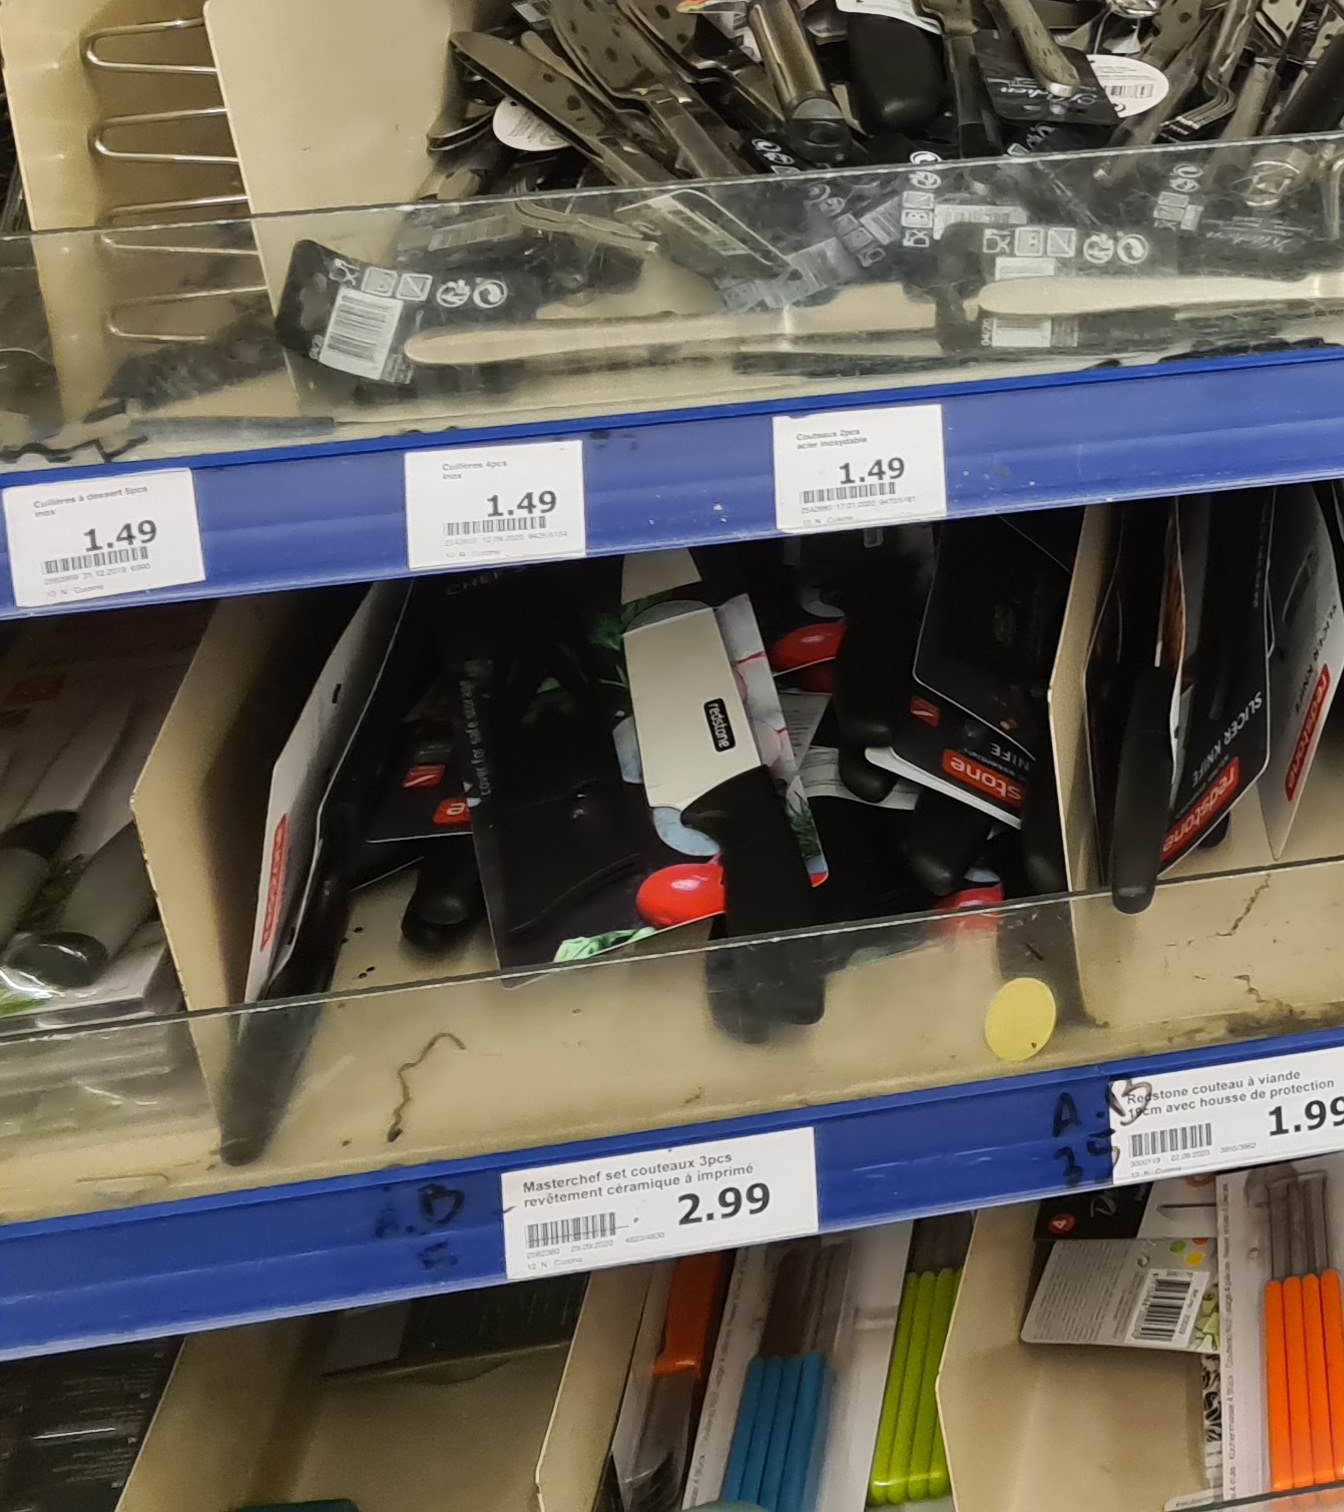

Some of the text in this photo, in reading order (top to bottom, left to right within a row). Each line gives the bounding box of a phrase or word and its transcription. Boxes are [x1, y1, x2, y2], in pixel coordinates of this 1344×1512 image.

[796, 430, 837, 441] Couteaux
[839, 456, 905, 485] 1.49
[87, 489, 122, 501] dessert
[486, 490, 557, 517] 1.49
[83, 519, 157, 553] 1.49
[708, 701, 730, 749] redstone
[1190, 691, 1263, 786] SLICER KNIFE
[950, 757, 1022, 801] stone
[1163, 769, 1237, 852] redstone
[1127, 1069, 1301, 1105] Redstone couteau à viande
[1166, 1078, 1335, 1114] avec housse de protection
[523, 1152, 732, 1193] Masterchef set couteaux 3pcs
[523, 1162, 754, 1208] revêtement céramique à imprimé
[677, 1182, 771, 1226] 2.99
